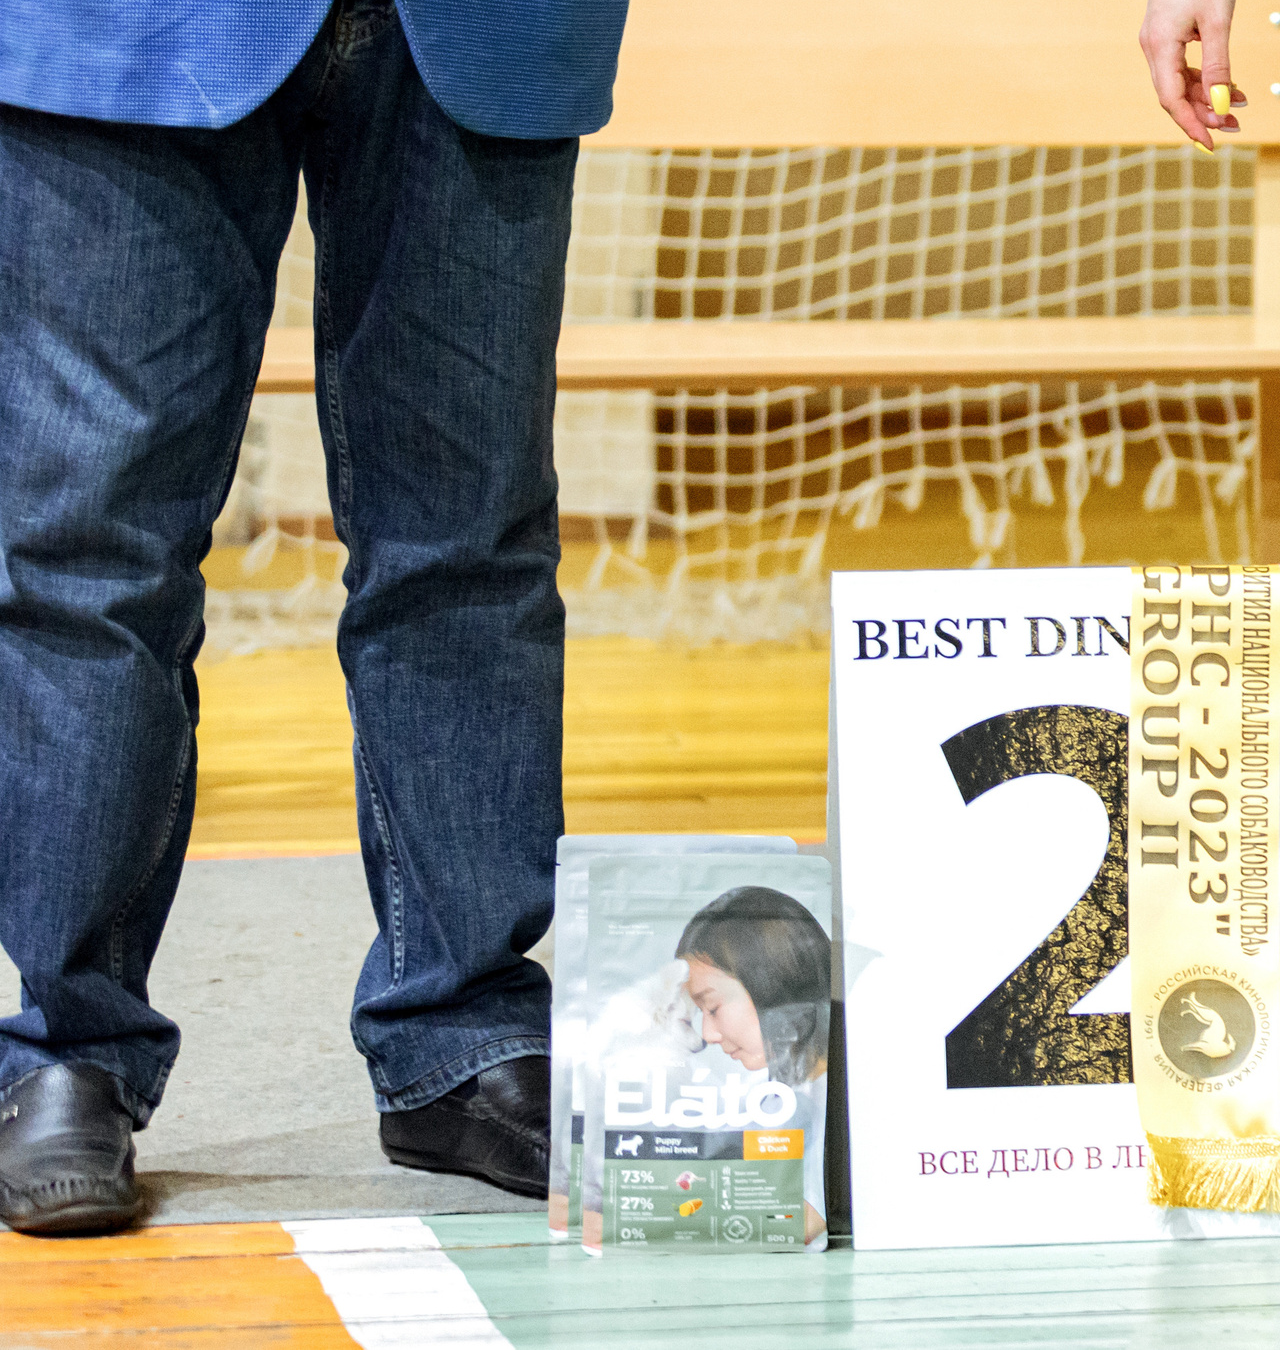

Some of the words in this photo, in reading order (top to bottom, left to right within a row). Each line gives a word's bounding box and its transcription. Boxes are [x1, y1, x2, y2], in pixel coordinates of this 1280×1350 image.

[852, 616, 1007, 661] BEST
[1023, 614, 1131, 658] DIN
[1140, 565, 1182, 799] GROUP
[1236, 627, 1271, 791] НАЦИОНАЛЬНОГО
[1140, 819, 1180, 870] II
[1233, 794, 1269, 956] СОБАКОВОДСТВА»
[939, 703, 1132, 1090] 2
[1153, 963, 1238, 1002] РОССИЙСКАЯ
[1153, 1053, 1224, 1093] ФЕДЕРАЦИЯ
[604, 1067, 798, 1129] Eláto
[655, 1136, 682, 1147] Puppy
[655, 1145, 673, 1154] Mini
[674, 1145, 698, 1154] breed
[621, 1169, 655, 1183] 73%
[916, 1150, 979, 1178] ВСЕ
[986, 1146, 1075, 1180] ДЕЛО
[1084, 1146, 1103, 1170] В
[621, 1196, 655, 1210] 27%
[620, 1227, 646, 1239] 0%
